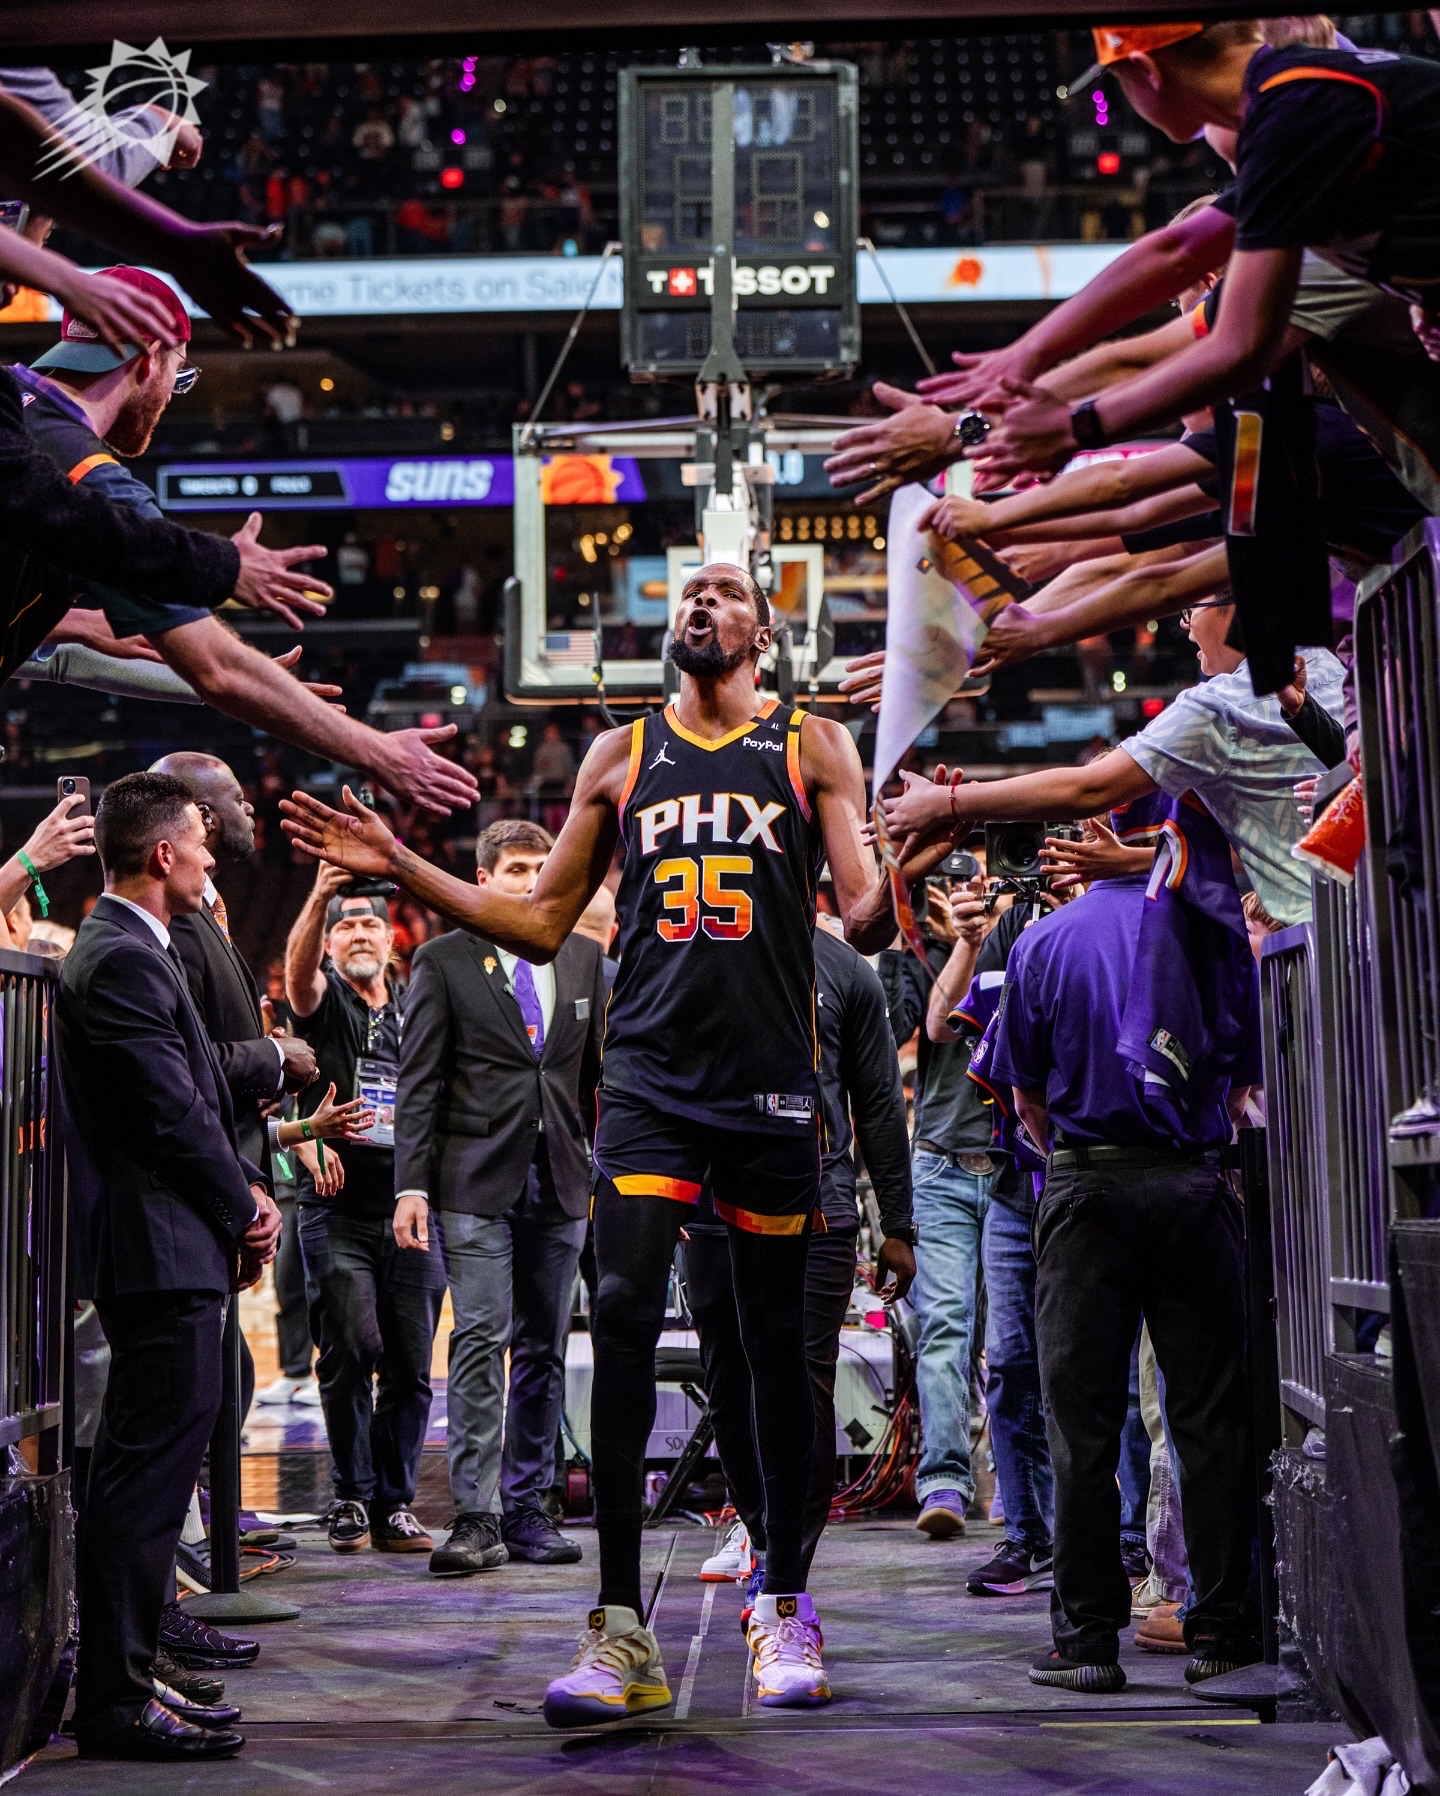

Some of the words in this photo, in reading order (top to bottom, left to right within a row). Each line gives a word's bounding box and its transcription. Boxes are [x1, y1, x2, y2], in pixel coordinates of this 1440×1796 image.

[346, 273, 466, 303] Tickets
[473, 274, 520, 301] on
[525, 267, 596, 298] Sale
[696, 264, 835, 295] TSSOT
[742, 736, 784, 752] PayPal
[635, 793, 786, 854] PHX
[653, 856, 753, 942] 35
